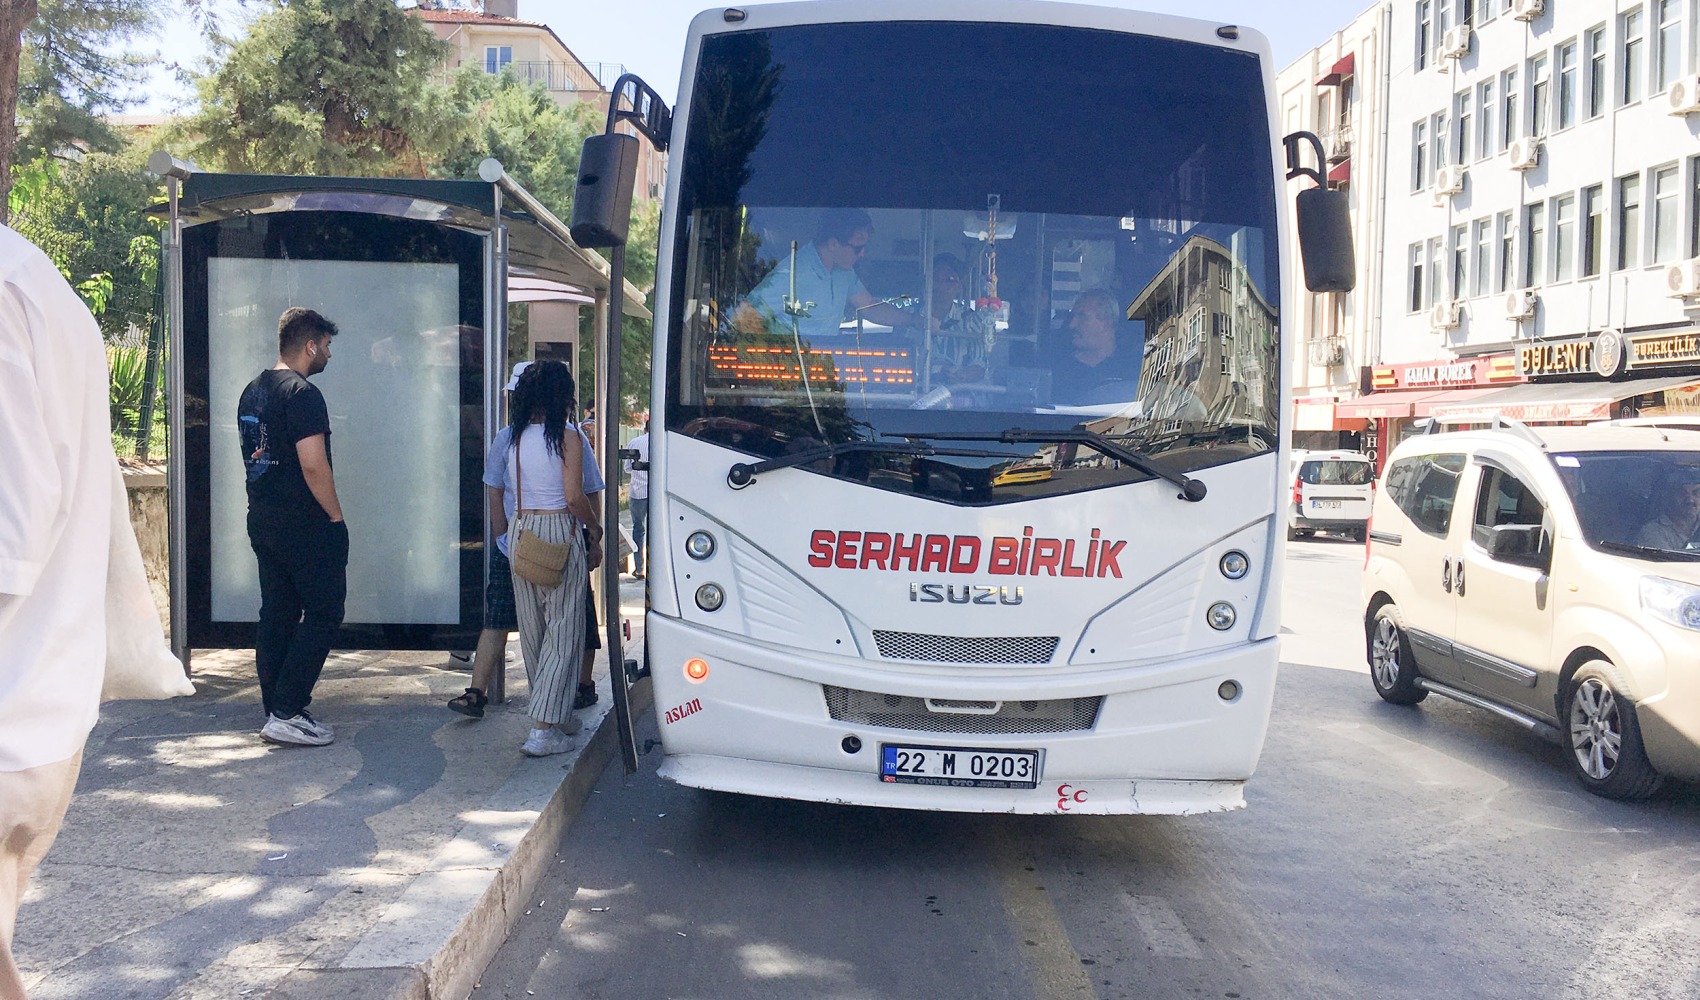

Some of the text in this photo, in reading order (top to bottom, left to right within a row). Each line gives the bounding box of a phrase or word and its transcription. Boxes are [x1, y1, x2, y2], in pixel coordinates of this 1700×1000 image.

[808, 526, 1127, 578] SERHAD BİRLİK
[909, 582, 1024, 606] ISUZU
[664, 698, 703, 724] ASLAN
[897, 752, 1029, 777] 22 M 0203
[951, 779, 974, 787] OTO
